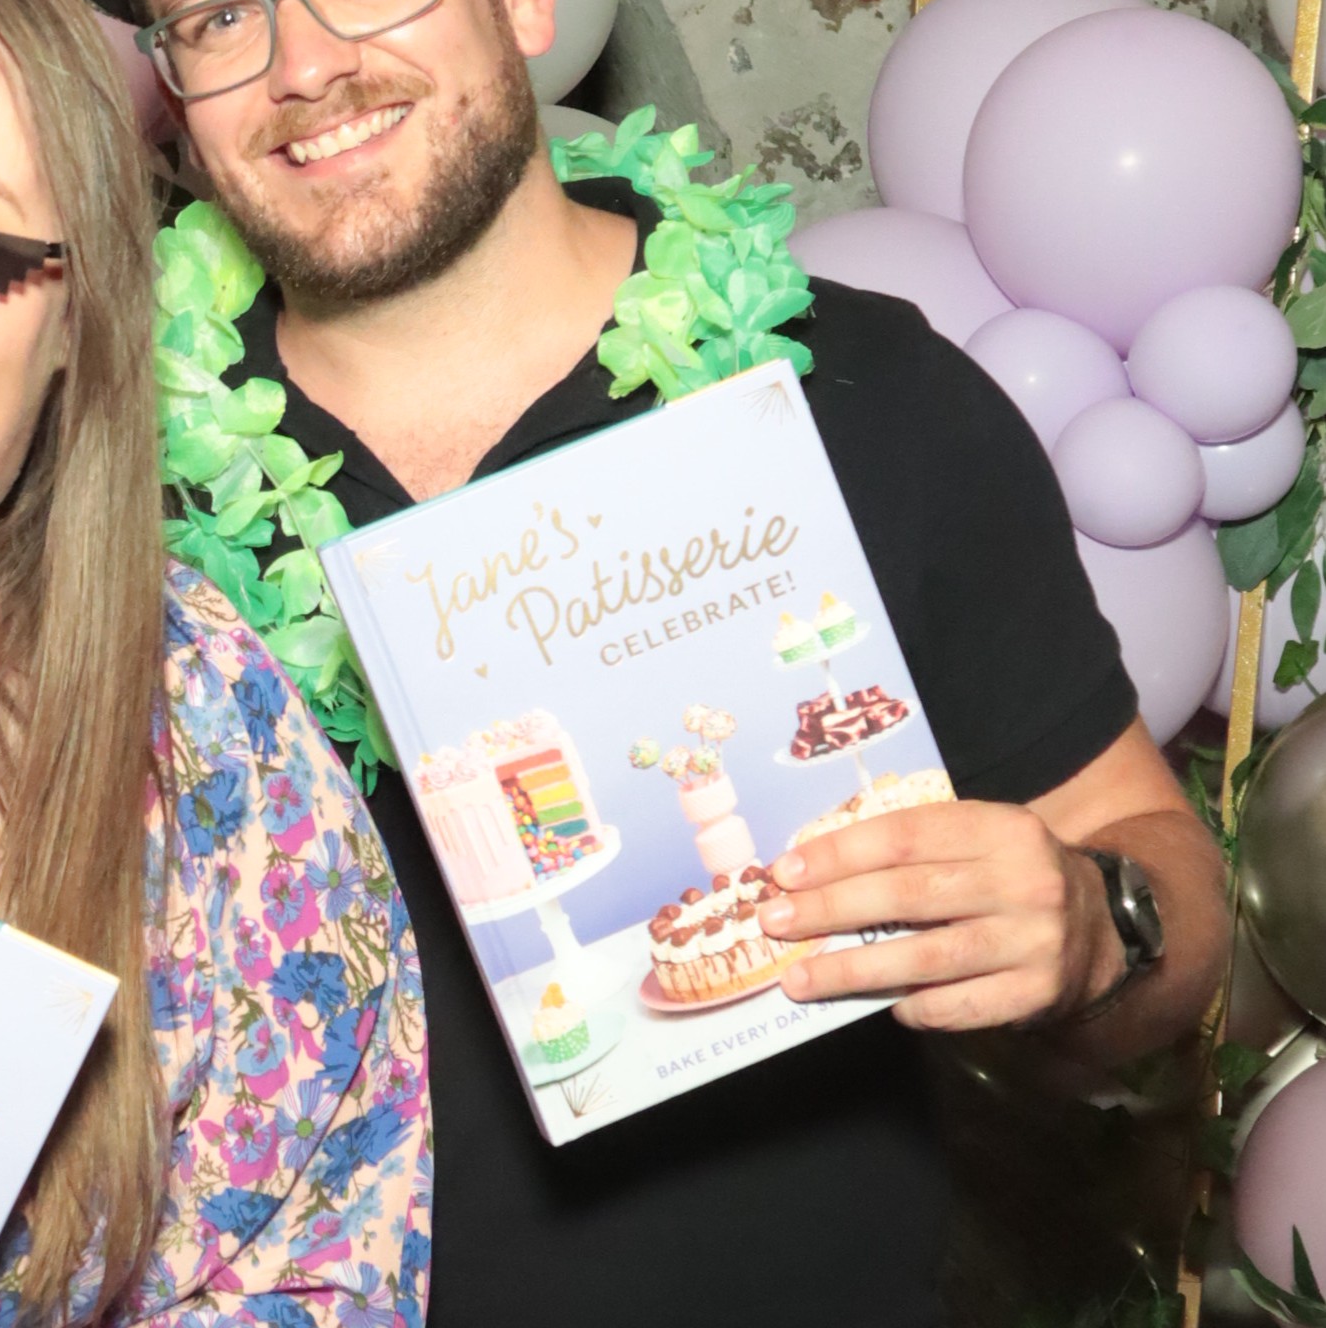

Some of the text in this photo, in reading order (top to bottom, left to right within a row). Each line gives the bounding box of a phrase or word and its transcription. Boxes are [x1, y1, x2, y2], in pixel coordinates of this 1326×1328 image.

[405, 502, 579, 661] Jane's
[506, 506, 800, 666] Patisserie
[600, 570, 797, 667] CELEBRATE!
[656, 1006, 810, 1079] BAKE EVERY DAY
